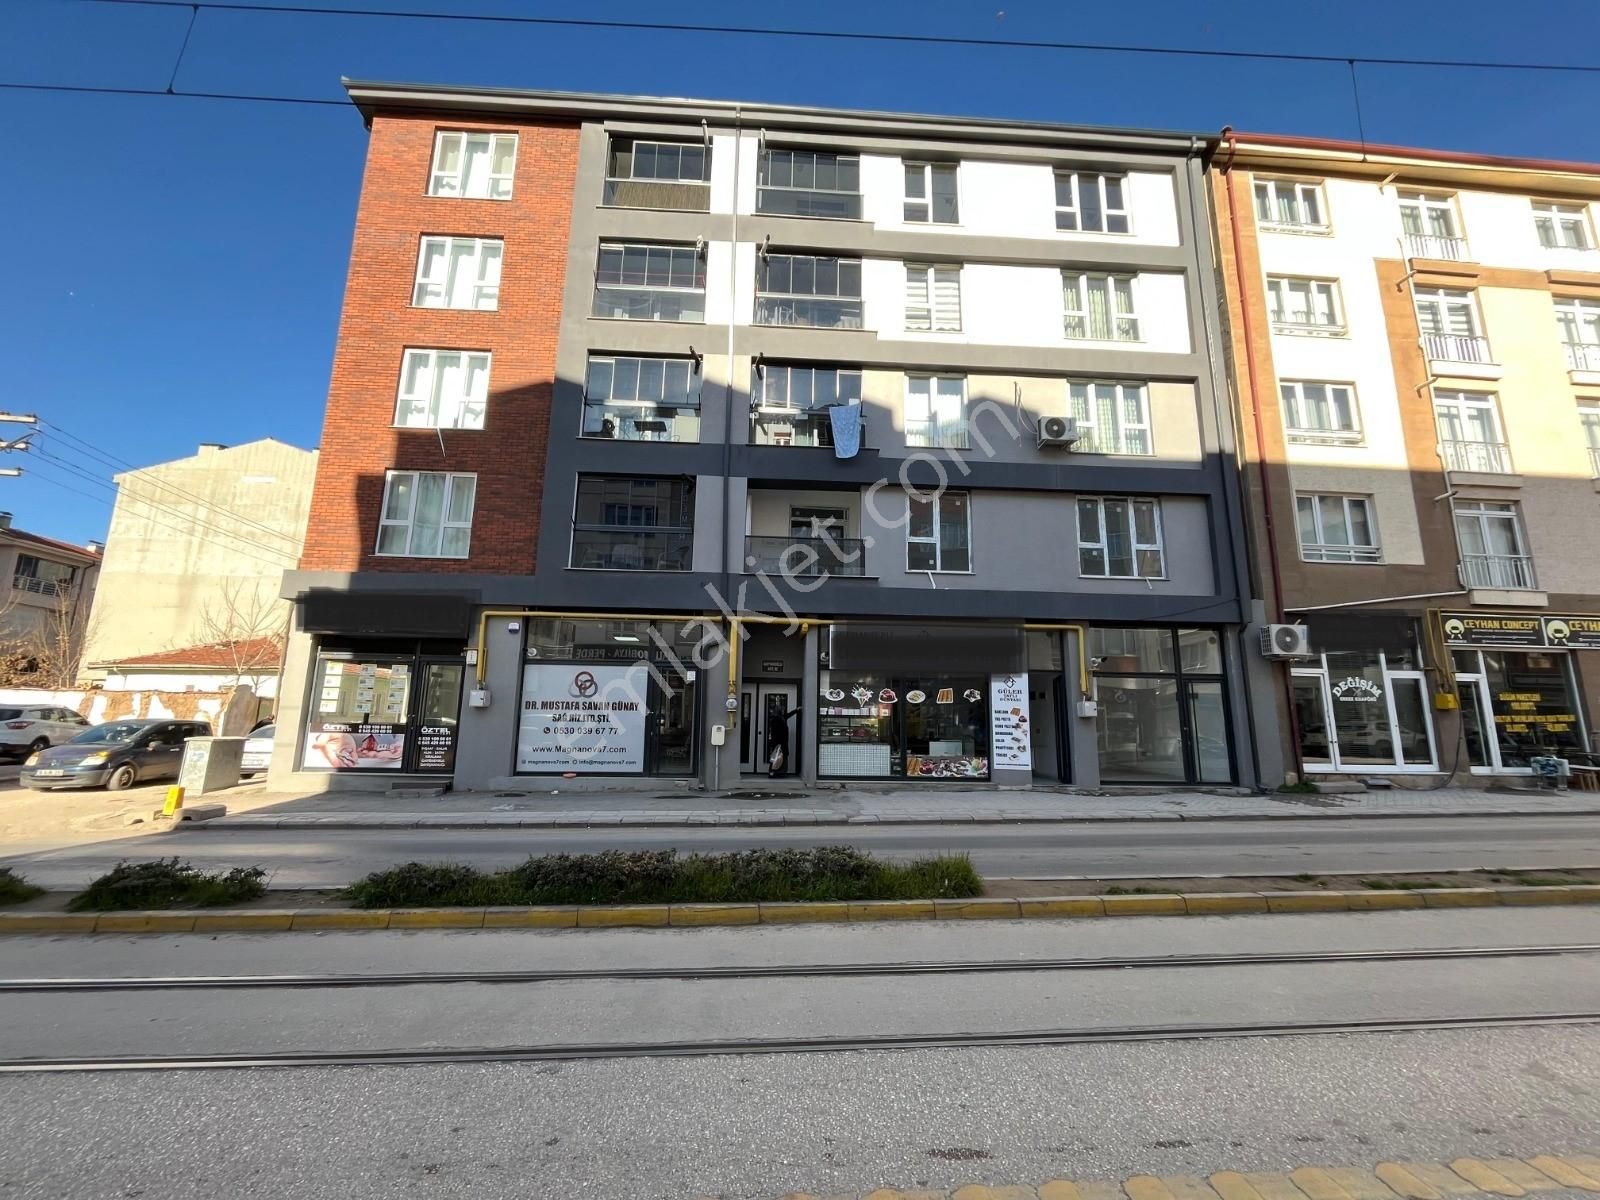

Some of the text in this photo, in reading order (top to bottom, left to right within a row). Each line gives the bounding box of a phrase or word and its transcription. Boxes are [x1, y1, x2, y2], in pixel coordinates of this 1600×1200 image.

[1463, 619, 1539, 631] CEYHAN CONCEPT
[1332, 676, 1383, 698] DEĞİŞİM
[524, 701, 539, 711] DR.
[541, 701, 580, 711] MUSTAFA
[611, 701, 639, 712] GÜNAY
[553, 727, 575, 735] 0530
[577, 727, 593, 735] 039
